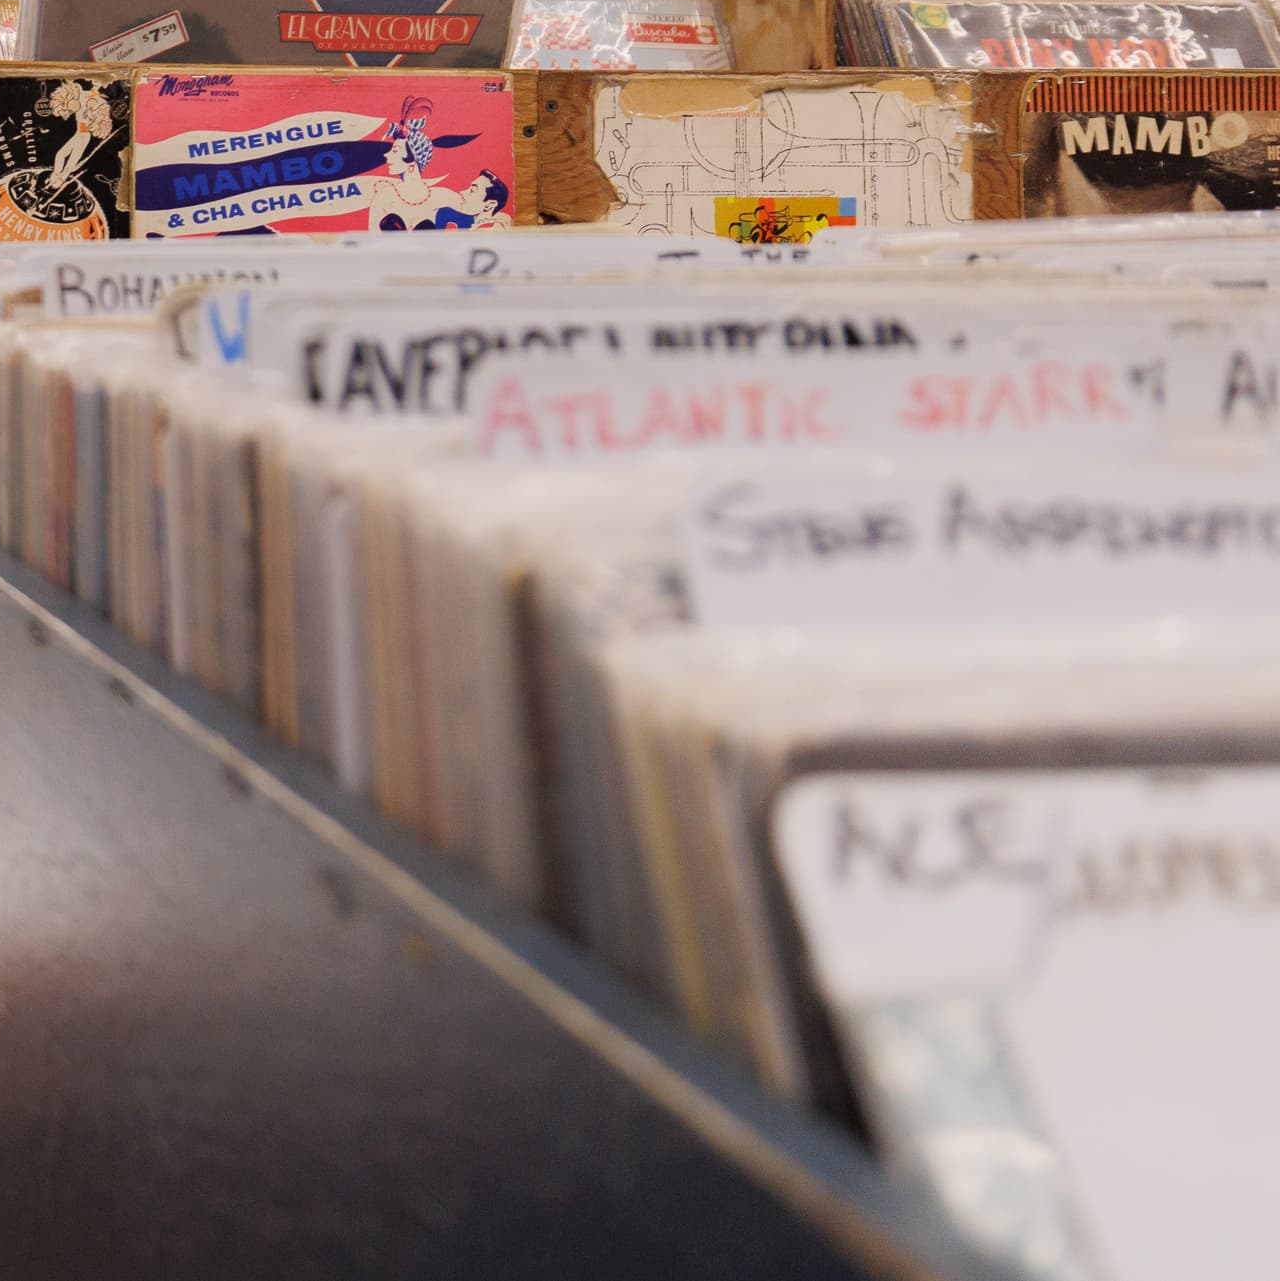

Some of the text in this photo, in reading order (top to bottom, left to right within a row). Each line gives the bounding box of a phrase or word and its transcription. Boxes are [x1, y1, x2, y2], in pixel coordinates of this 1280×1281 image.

[287, 14, 471, 42] EL GRAN COMBO
[158, 74, 235, 98] Monogram
[188, 119, 345, 158] MERENGUE
[1060, 112, 1250, 158] MAMBO
[171, 150, 347, 202] MAMBO
[192, 181, 363, 226] CHA CHA CHA
